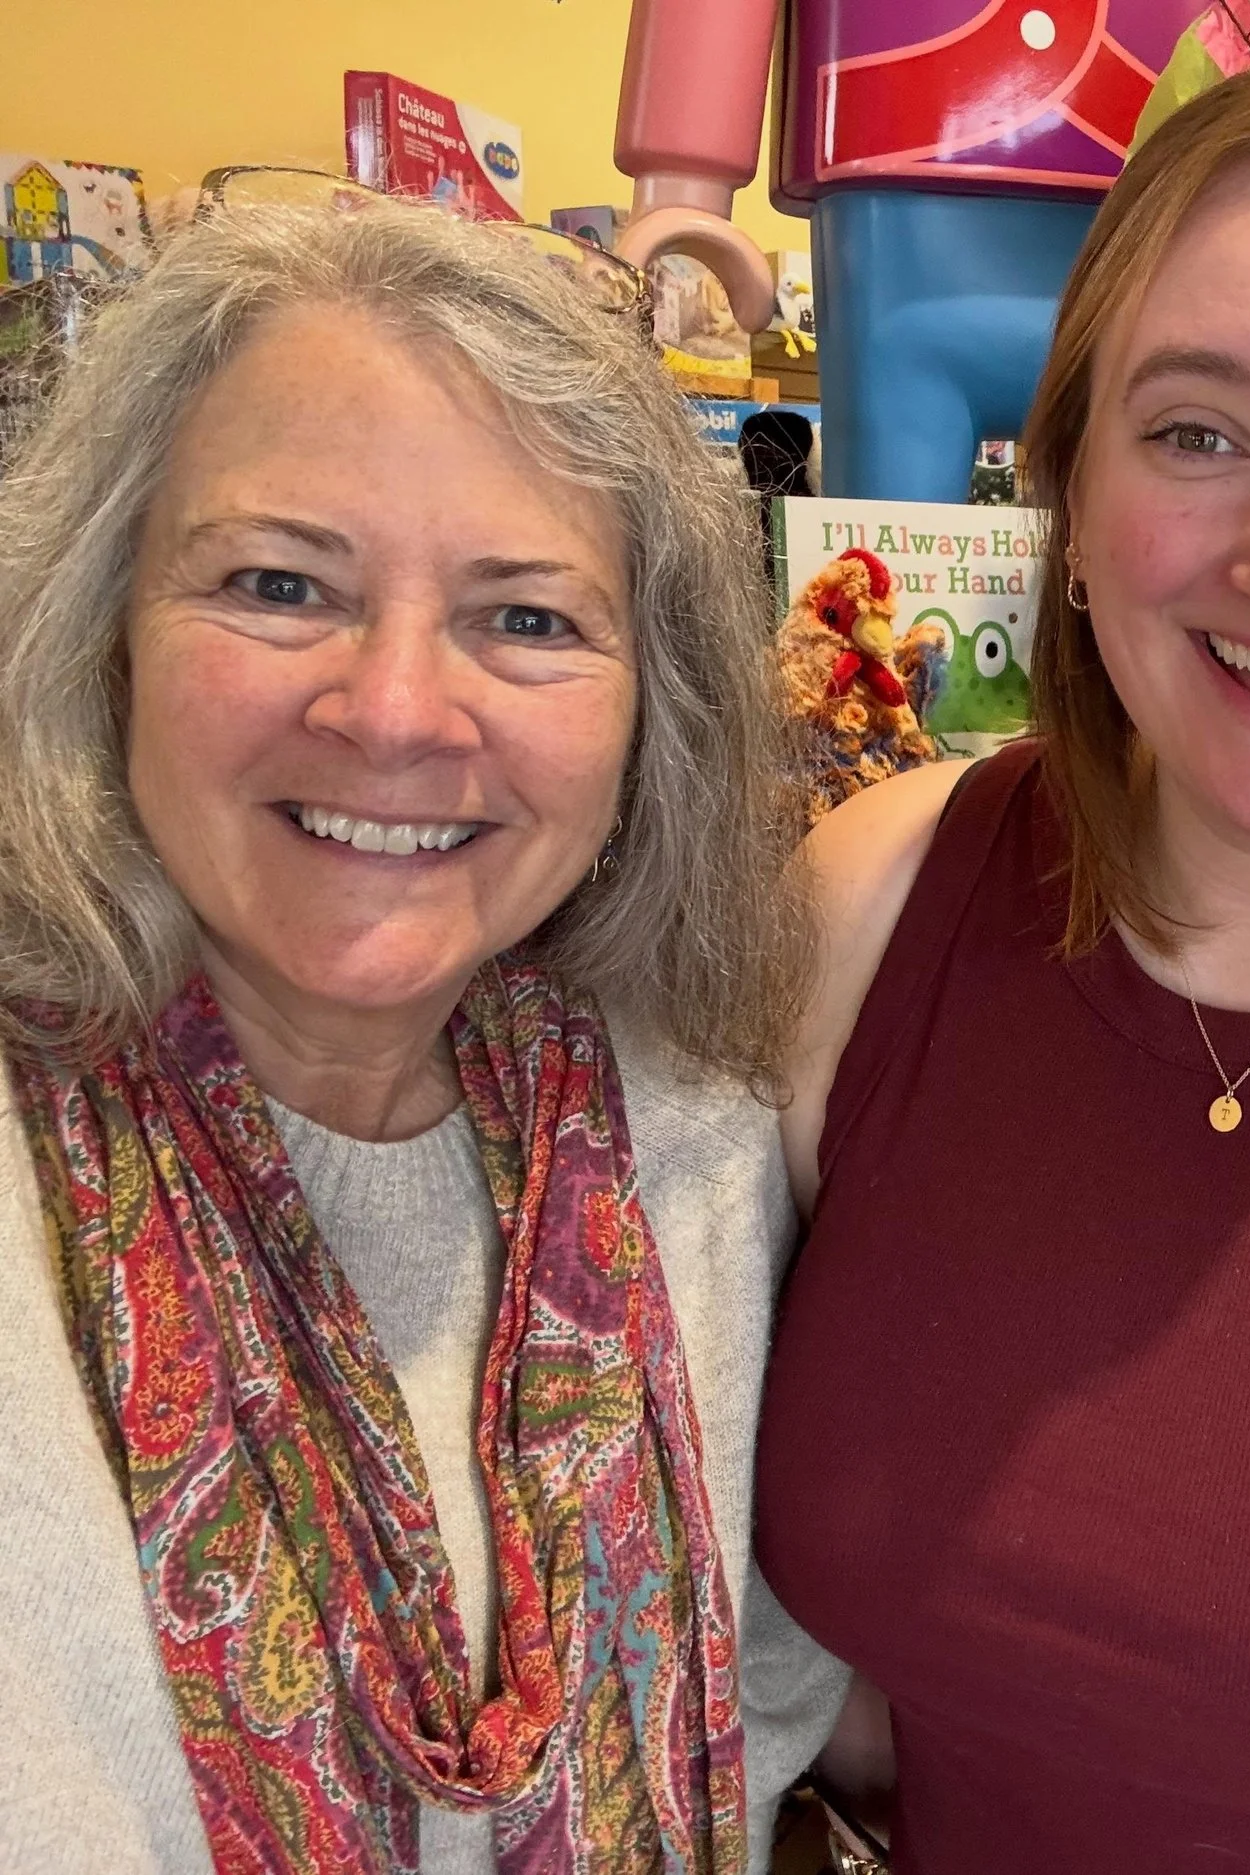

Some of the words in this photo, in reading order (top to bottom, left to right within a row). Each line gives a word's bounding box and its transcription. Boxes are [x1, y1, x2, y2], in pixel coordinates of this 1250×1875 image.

[397, 92, 445, 129] Château
[822, 522, 866, 551] I'll
[874, 525, 987, 563] Always
[894, 573, 937, 594] our
[948, 567, 1026, 596] Hand
